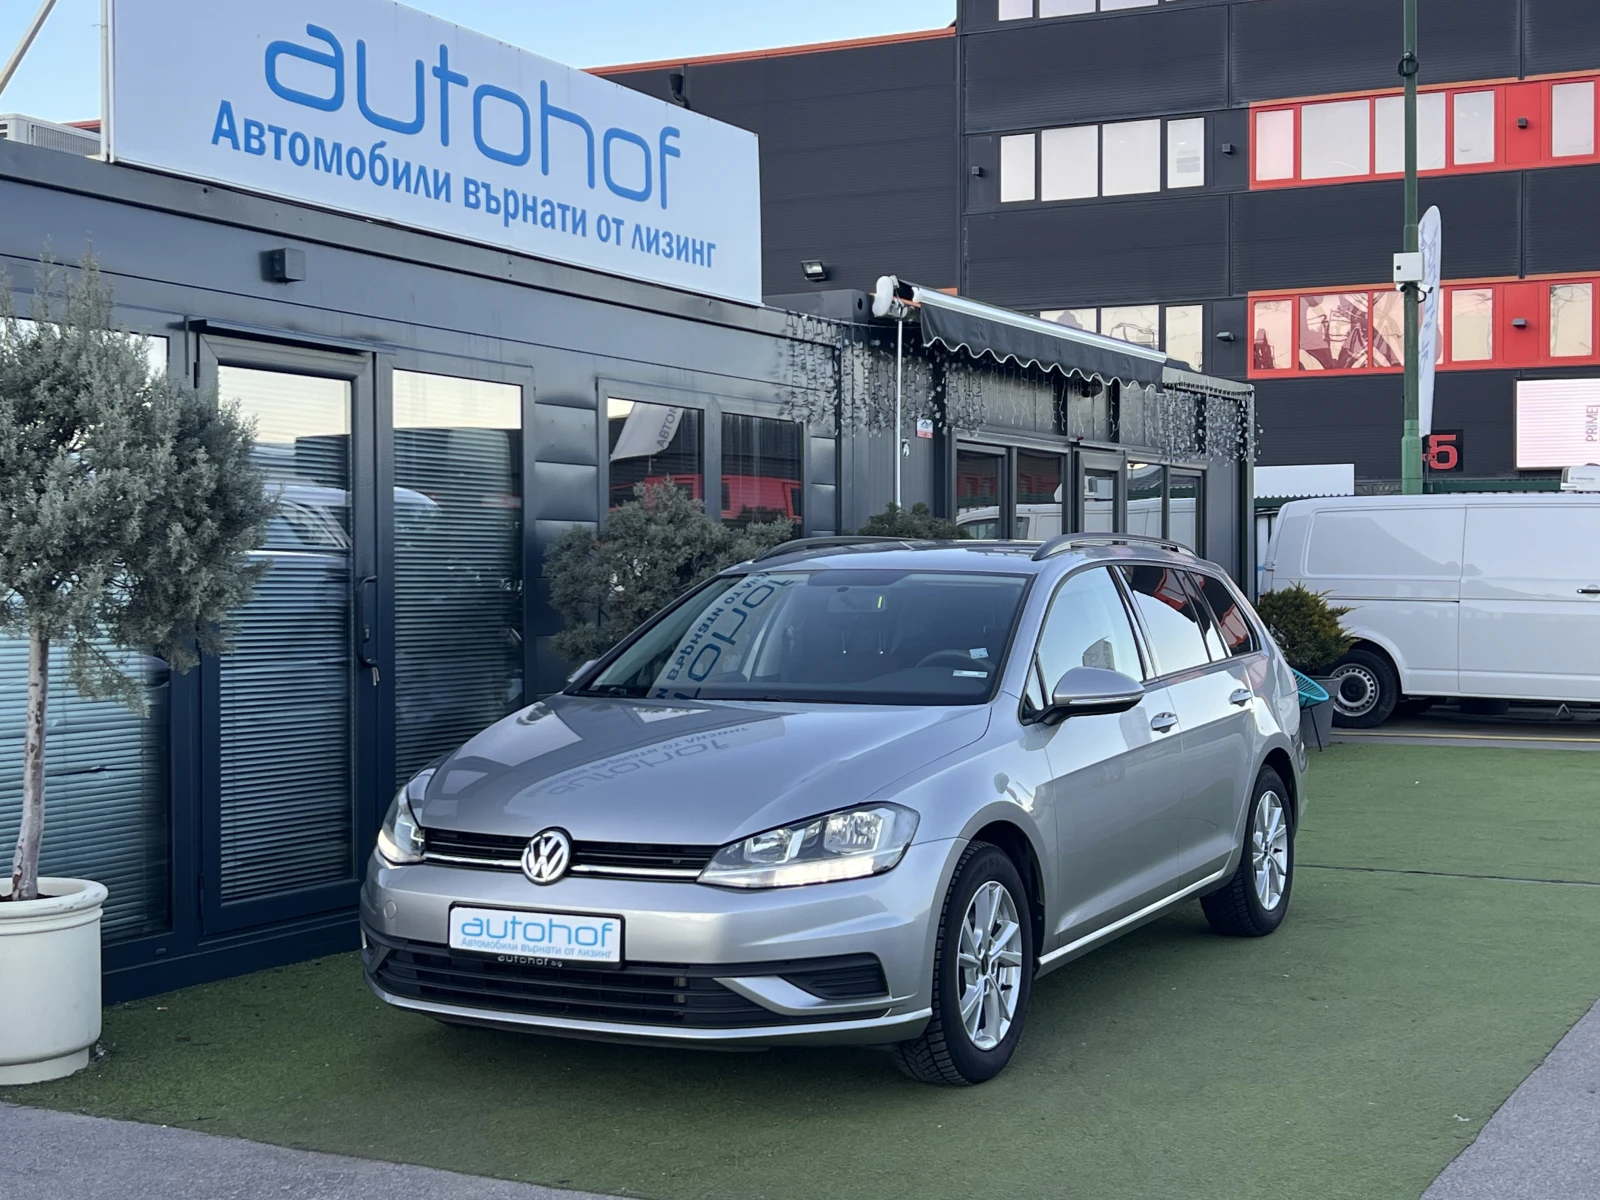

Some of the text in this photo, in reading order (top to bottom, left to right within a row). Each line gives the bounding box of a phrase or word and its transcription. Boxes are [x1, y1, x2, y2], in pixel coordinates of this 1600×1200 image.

[264, 23, 681, 210] autohof
[211, 99, 717, 268] Автомобили върнати от лизинг
[461, 915, 613, 947] autohof
[461, 937, 613, 959] Автомобили върнати от лизинг
